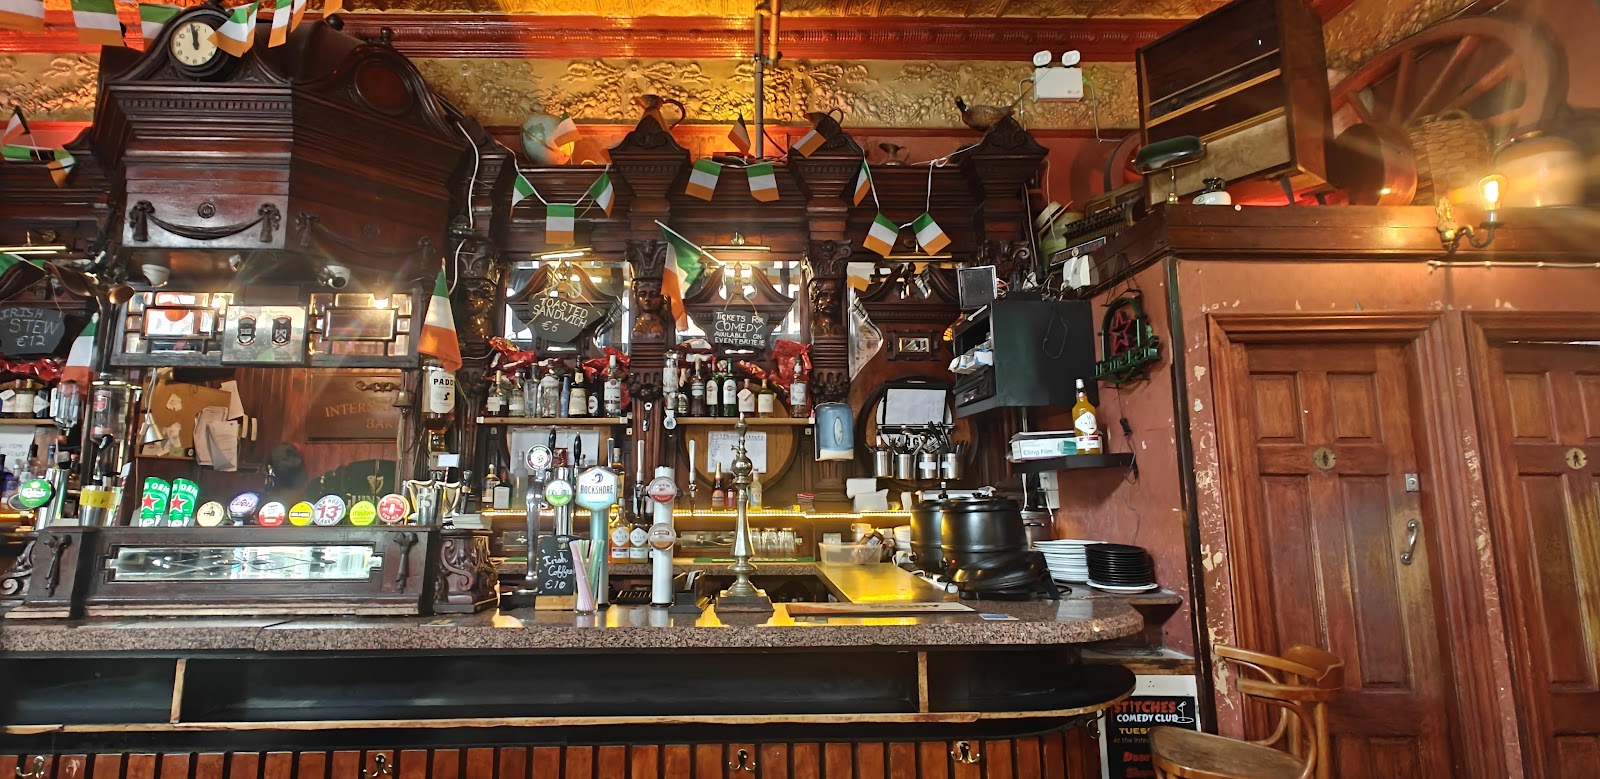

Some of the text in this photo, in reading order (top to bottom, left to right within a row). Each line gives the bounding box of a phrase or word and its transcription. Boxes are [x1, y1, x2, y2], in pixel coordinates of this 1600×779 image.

[0, 307, 44, 319] IRISH
[539, 297, 589, 319] TOASTED
[532, 304, 588, 328] SANDWICH
[751, 315, 765, 325] FOR
[9, 317, 61, 335] STEW
[715, 320, 763, 333] COMEDY
[16, 335, 46, 347] €12
[714, 331, 747, 339] AVAILABLE
[433, 378, 454, 386] PADD
[366, 418, 393, 429] BAR
[580, 484, 614, 495] ROCKSHORE
[319, 504, 339, 519] 13
[542, 551, 569, 567] Irish
[547, 565, 574, 579] Coffee
[1113, 700, 1177, 714] STITCHES
[1116, 713, 1179, 723] COMEDY CLUB
[1118, 727, 1151, 735] TUES
